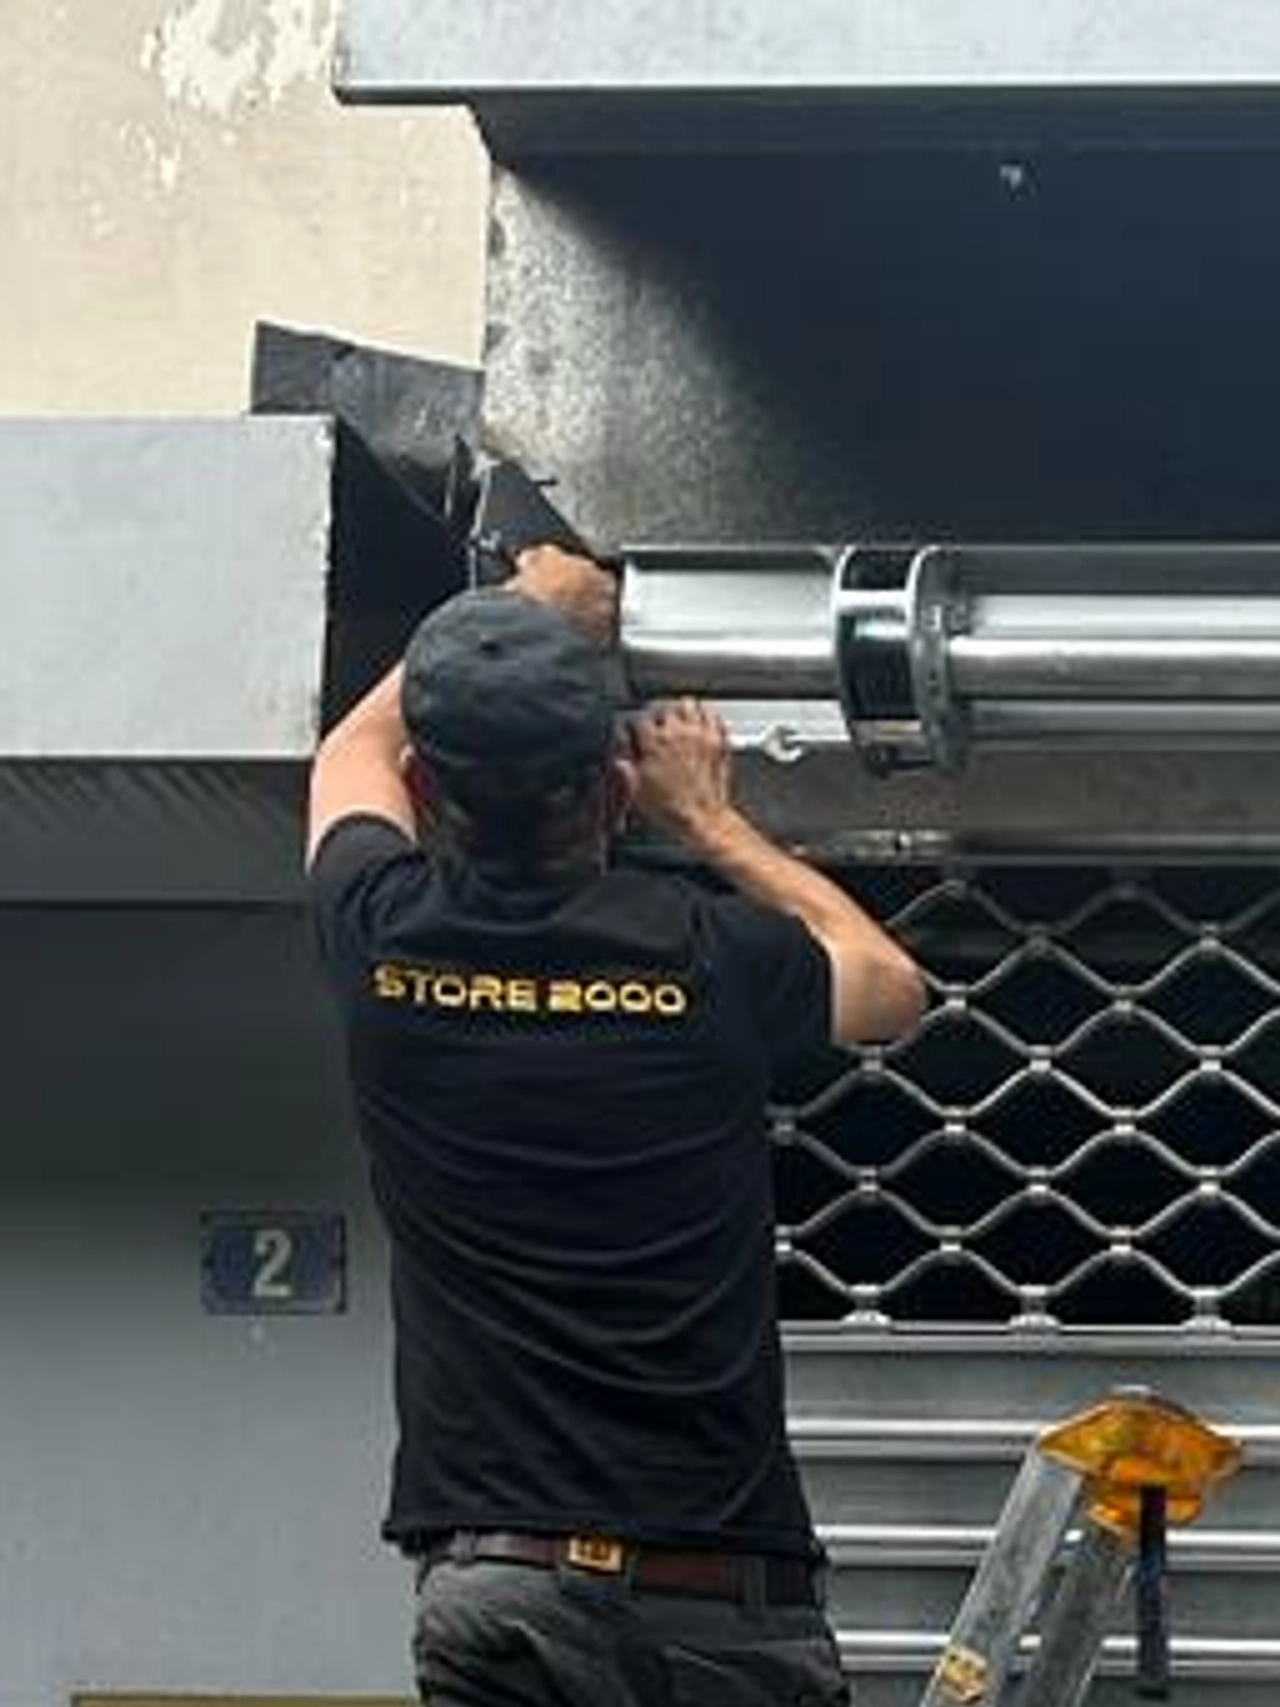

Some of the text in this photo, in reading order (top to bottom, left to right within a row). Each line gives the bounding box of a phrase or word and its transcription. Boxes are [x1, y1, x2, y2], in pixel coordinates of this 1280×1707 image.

[374, 963, 687, 1015] STORE 2000
[252, 1229, 292, 1297] 2
